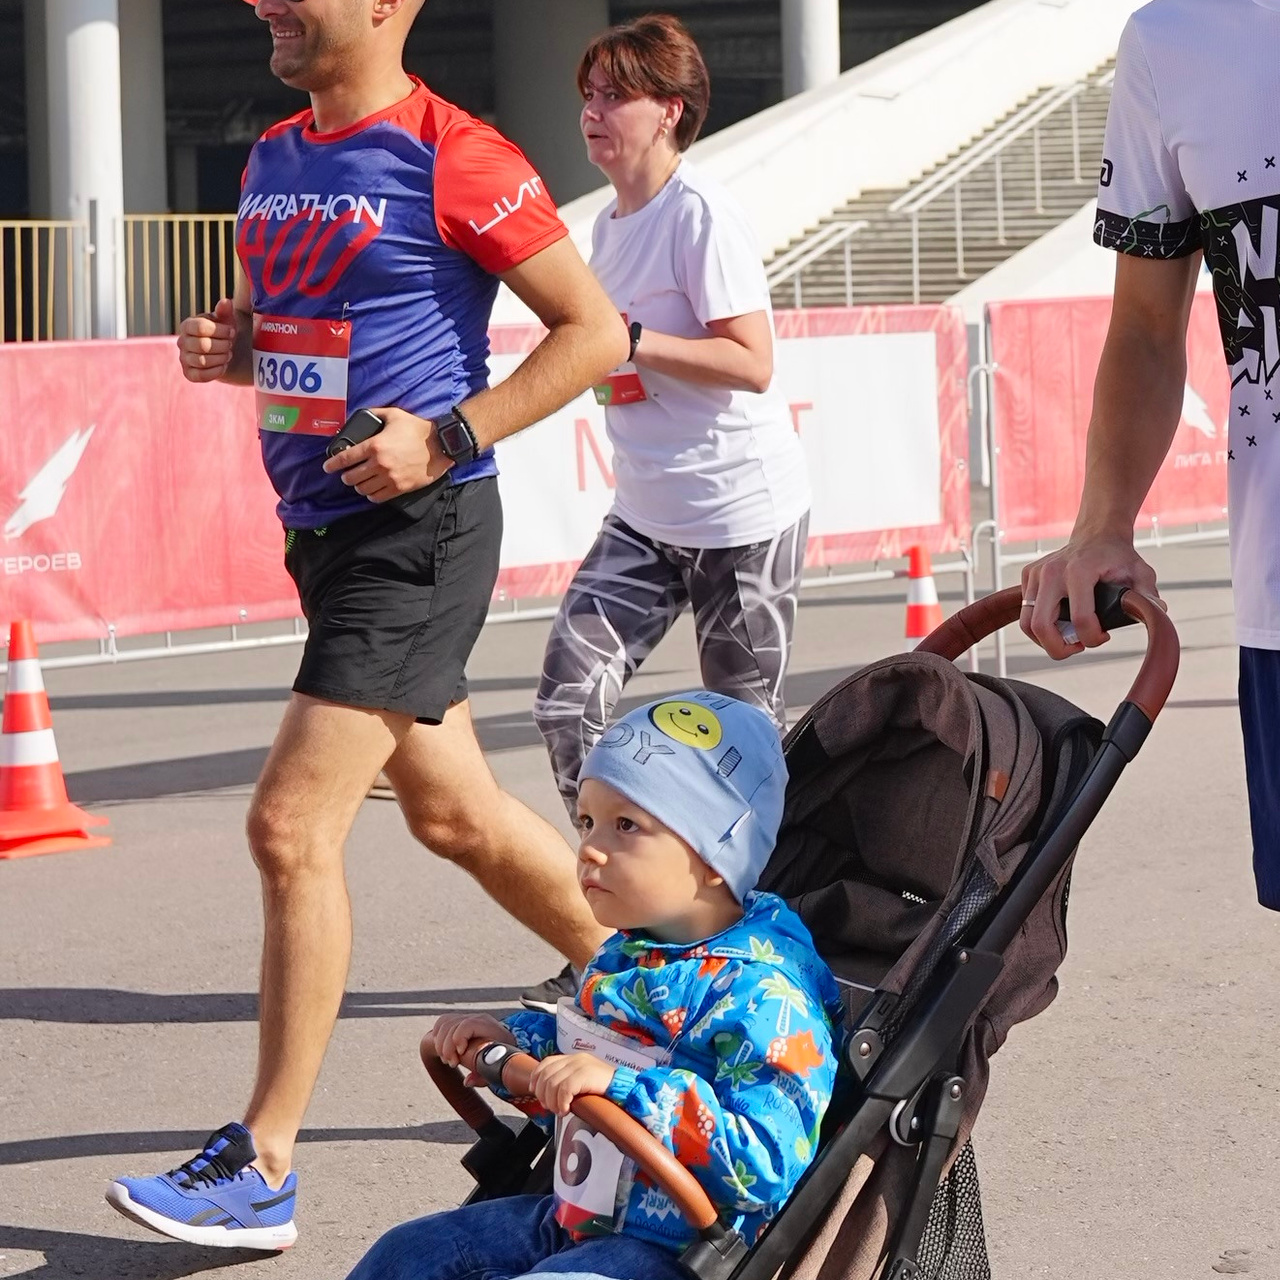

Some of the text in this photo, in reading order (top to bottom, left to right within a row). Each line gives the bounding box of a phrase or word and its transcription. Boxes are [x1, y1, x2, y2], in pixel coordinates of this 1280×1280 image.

[236, 192, 387, 228] MARATHON
[257, 356, 322, 394] 6306
[0, 551, 82, 575] ЕРОЕВ
